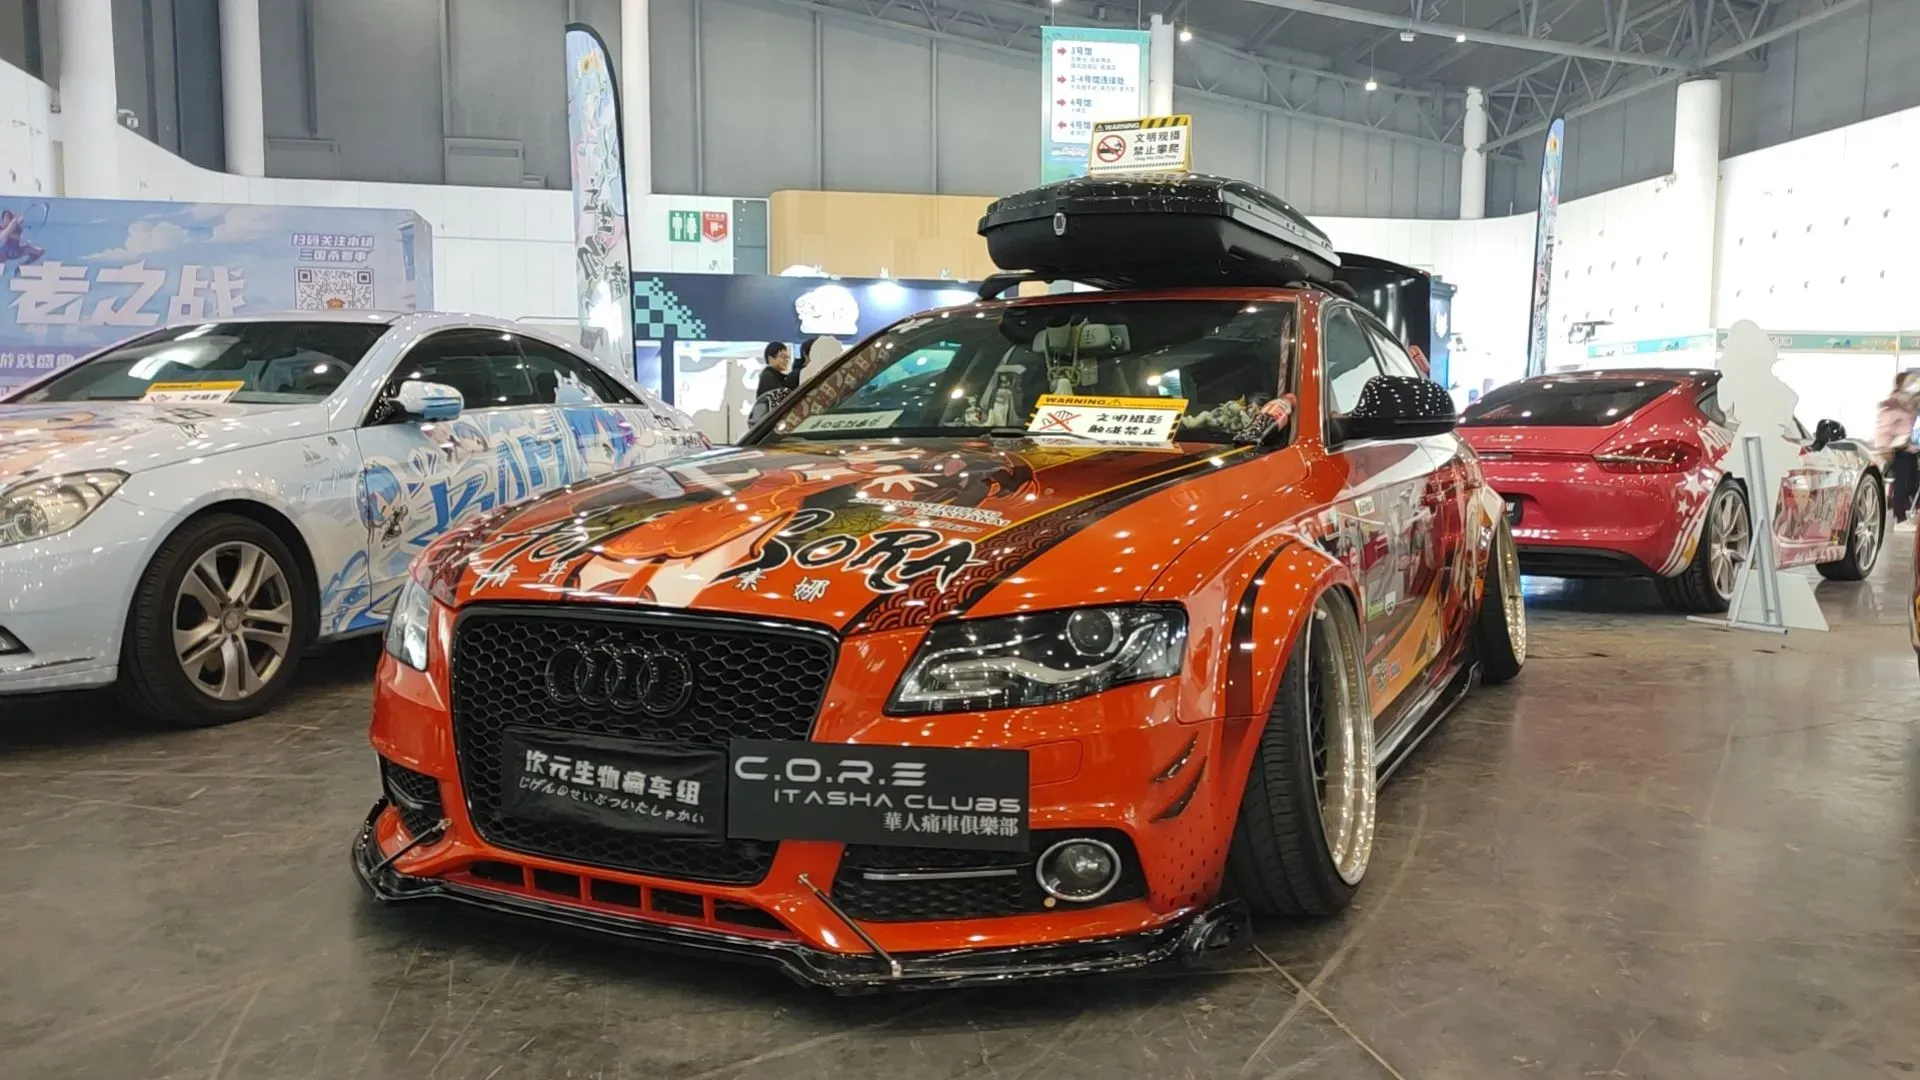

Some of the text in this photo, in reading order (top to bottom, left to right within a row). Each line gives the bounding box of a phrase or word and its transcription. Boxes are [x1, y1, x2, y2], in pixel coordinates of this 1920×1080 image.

[1104, 122, 1139, 131] WARNING
[1045, 397, 1106, 405] WARNING
[525, 750, 701, 806] 次元生物痛车组
[734, 756, 927, 787] C.O.R.E
[774, 788, 1021, 813] ITASHA CLUBS
[883, 811, 1019, 837] 華人痛車俱樂部
